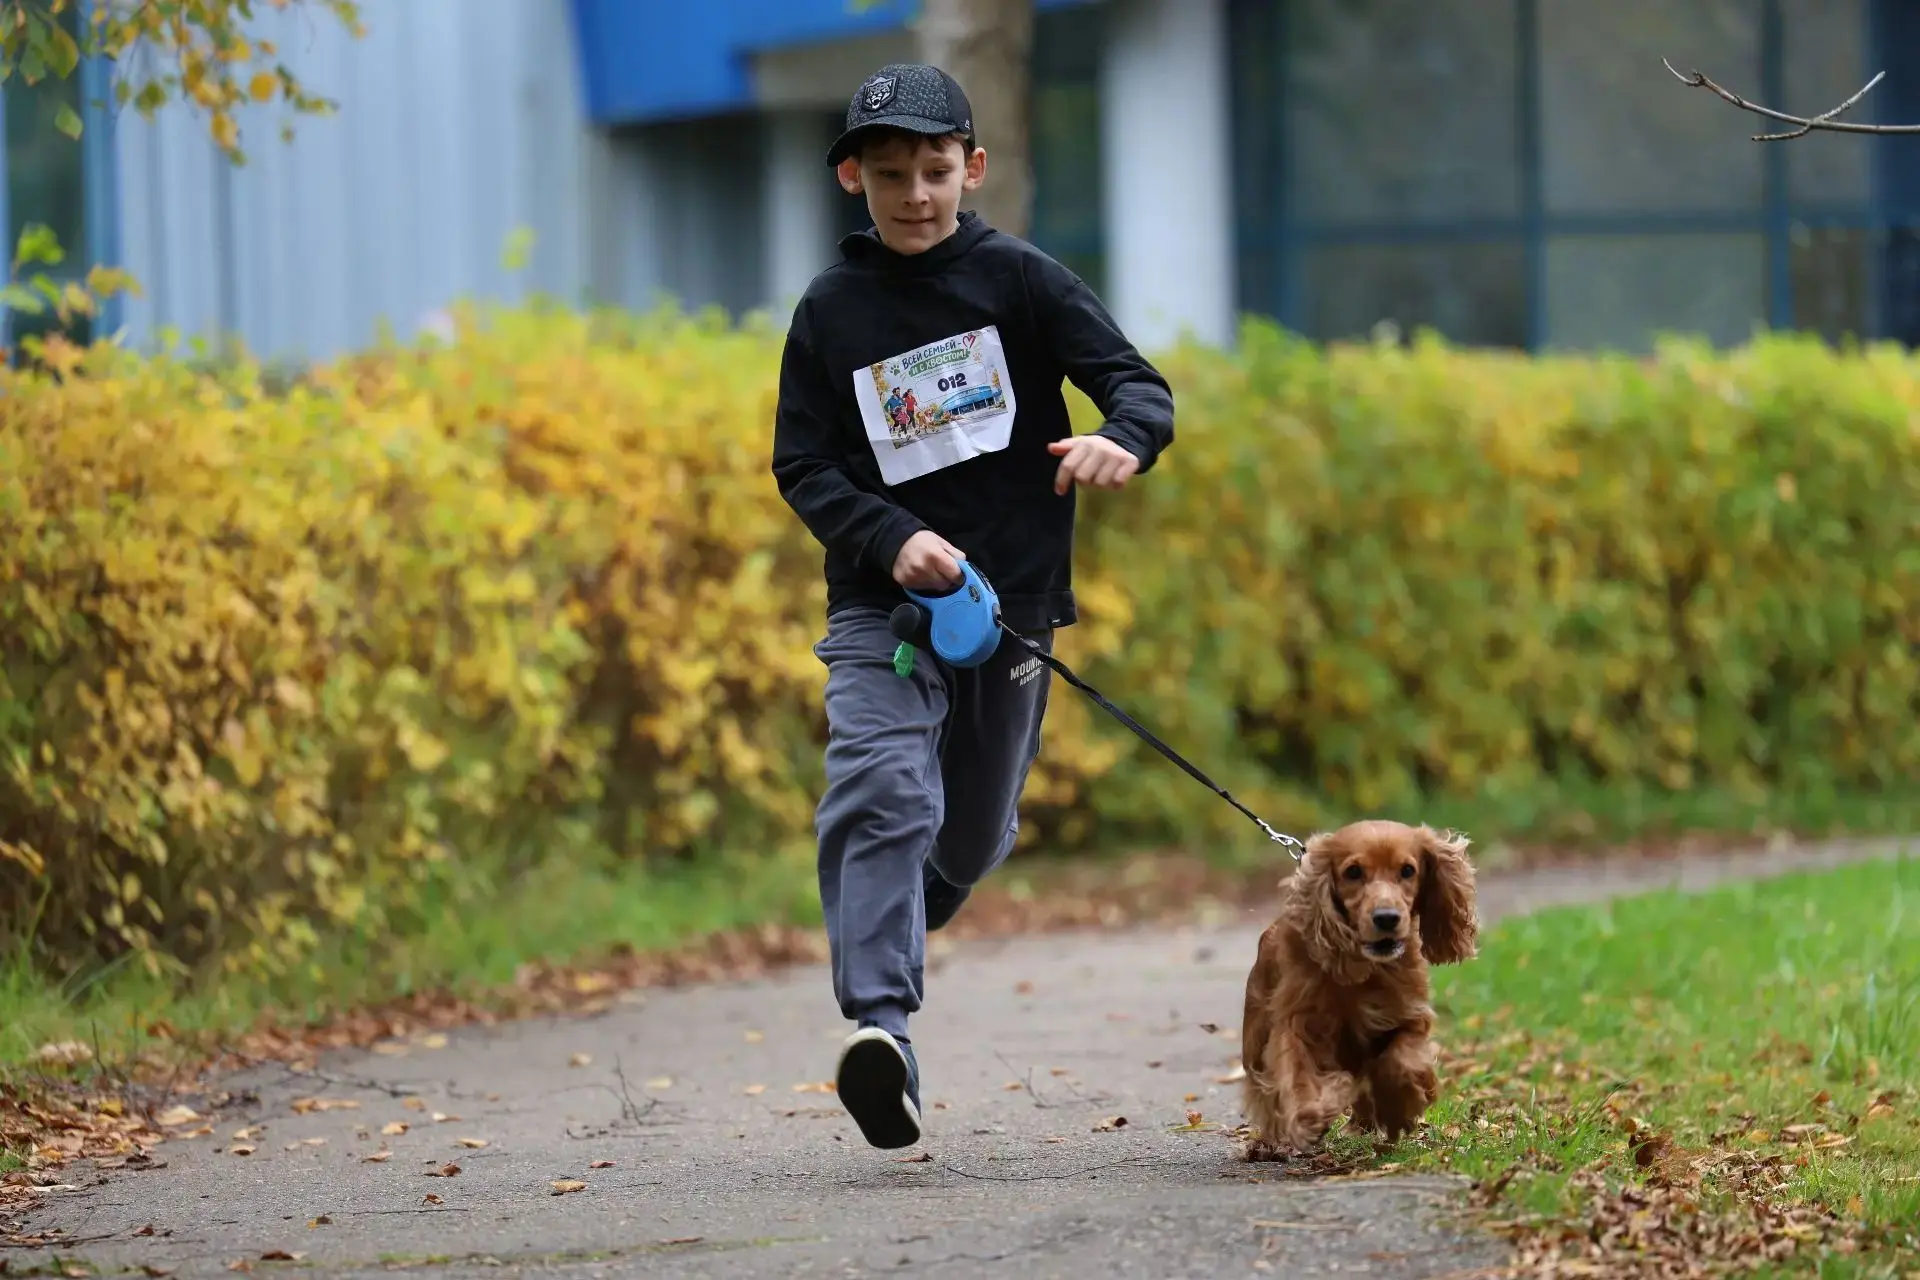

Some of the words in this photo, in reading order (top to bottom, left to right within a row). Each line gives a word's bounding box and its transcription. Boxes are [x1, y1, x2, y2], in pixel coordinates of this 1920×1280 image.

[902, 351, 923, 370] ВСЕЙ
[923, 339, 957, 358] СЕМЬЕЙ
[937, 373, 968, 392] 012
